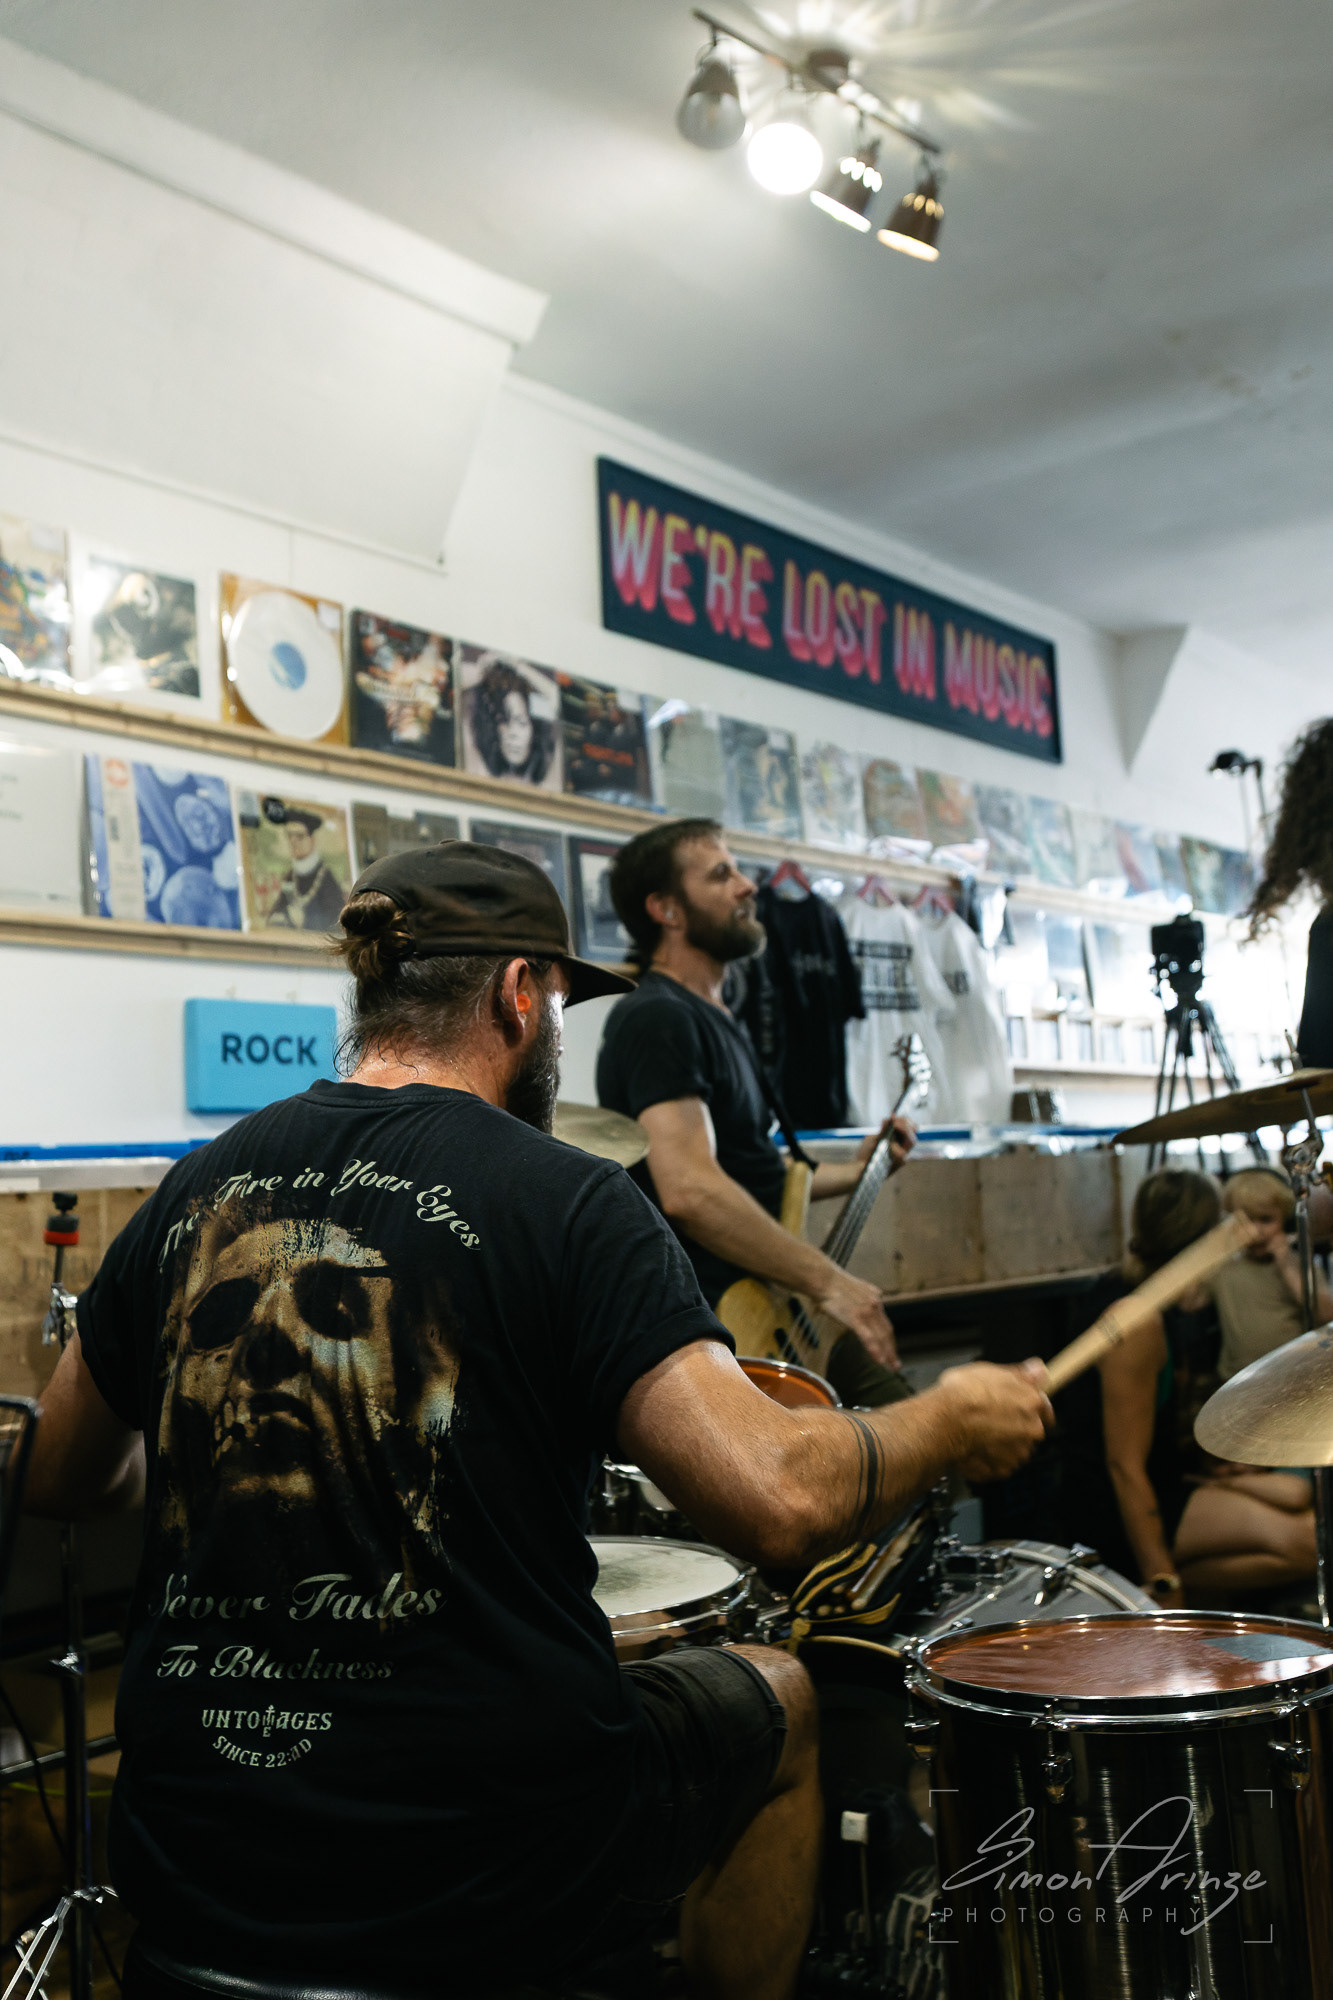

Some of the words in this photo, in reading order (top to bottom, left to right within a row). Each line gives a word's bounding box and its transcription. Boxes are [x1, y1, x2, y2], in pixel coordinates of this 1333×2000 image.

[608, 491, 774, 650] WE'RE
[783, 558, 885, 684] LOST
[893, 603, 936, 701] IN
[944, 620, 1054, 738] MUSIC
[221, 1031, 318, 1067] ROCK
[157, 1211, 200, 1275] Te
[213, 1170, 285, 1212] Fire
[292, 1167, 329, 1189] in
[330, 1158, 414, 1197] Your
[416, 1184, 480, 1250] Eyes
[288, 1572, 448, 1621] Fades
[156, 1644, 200, 1678] To
[209, 1645, 396, 1680] Blackness
[201, 1708, 260, 1730] UNTO
[212, 1735, 263, 1767] SINCE
